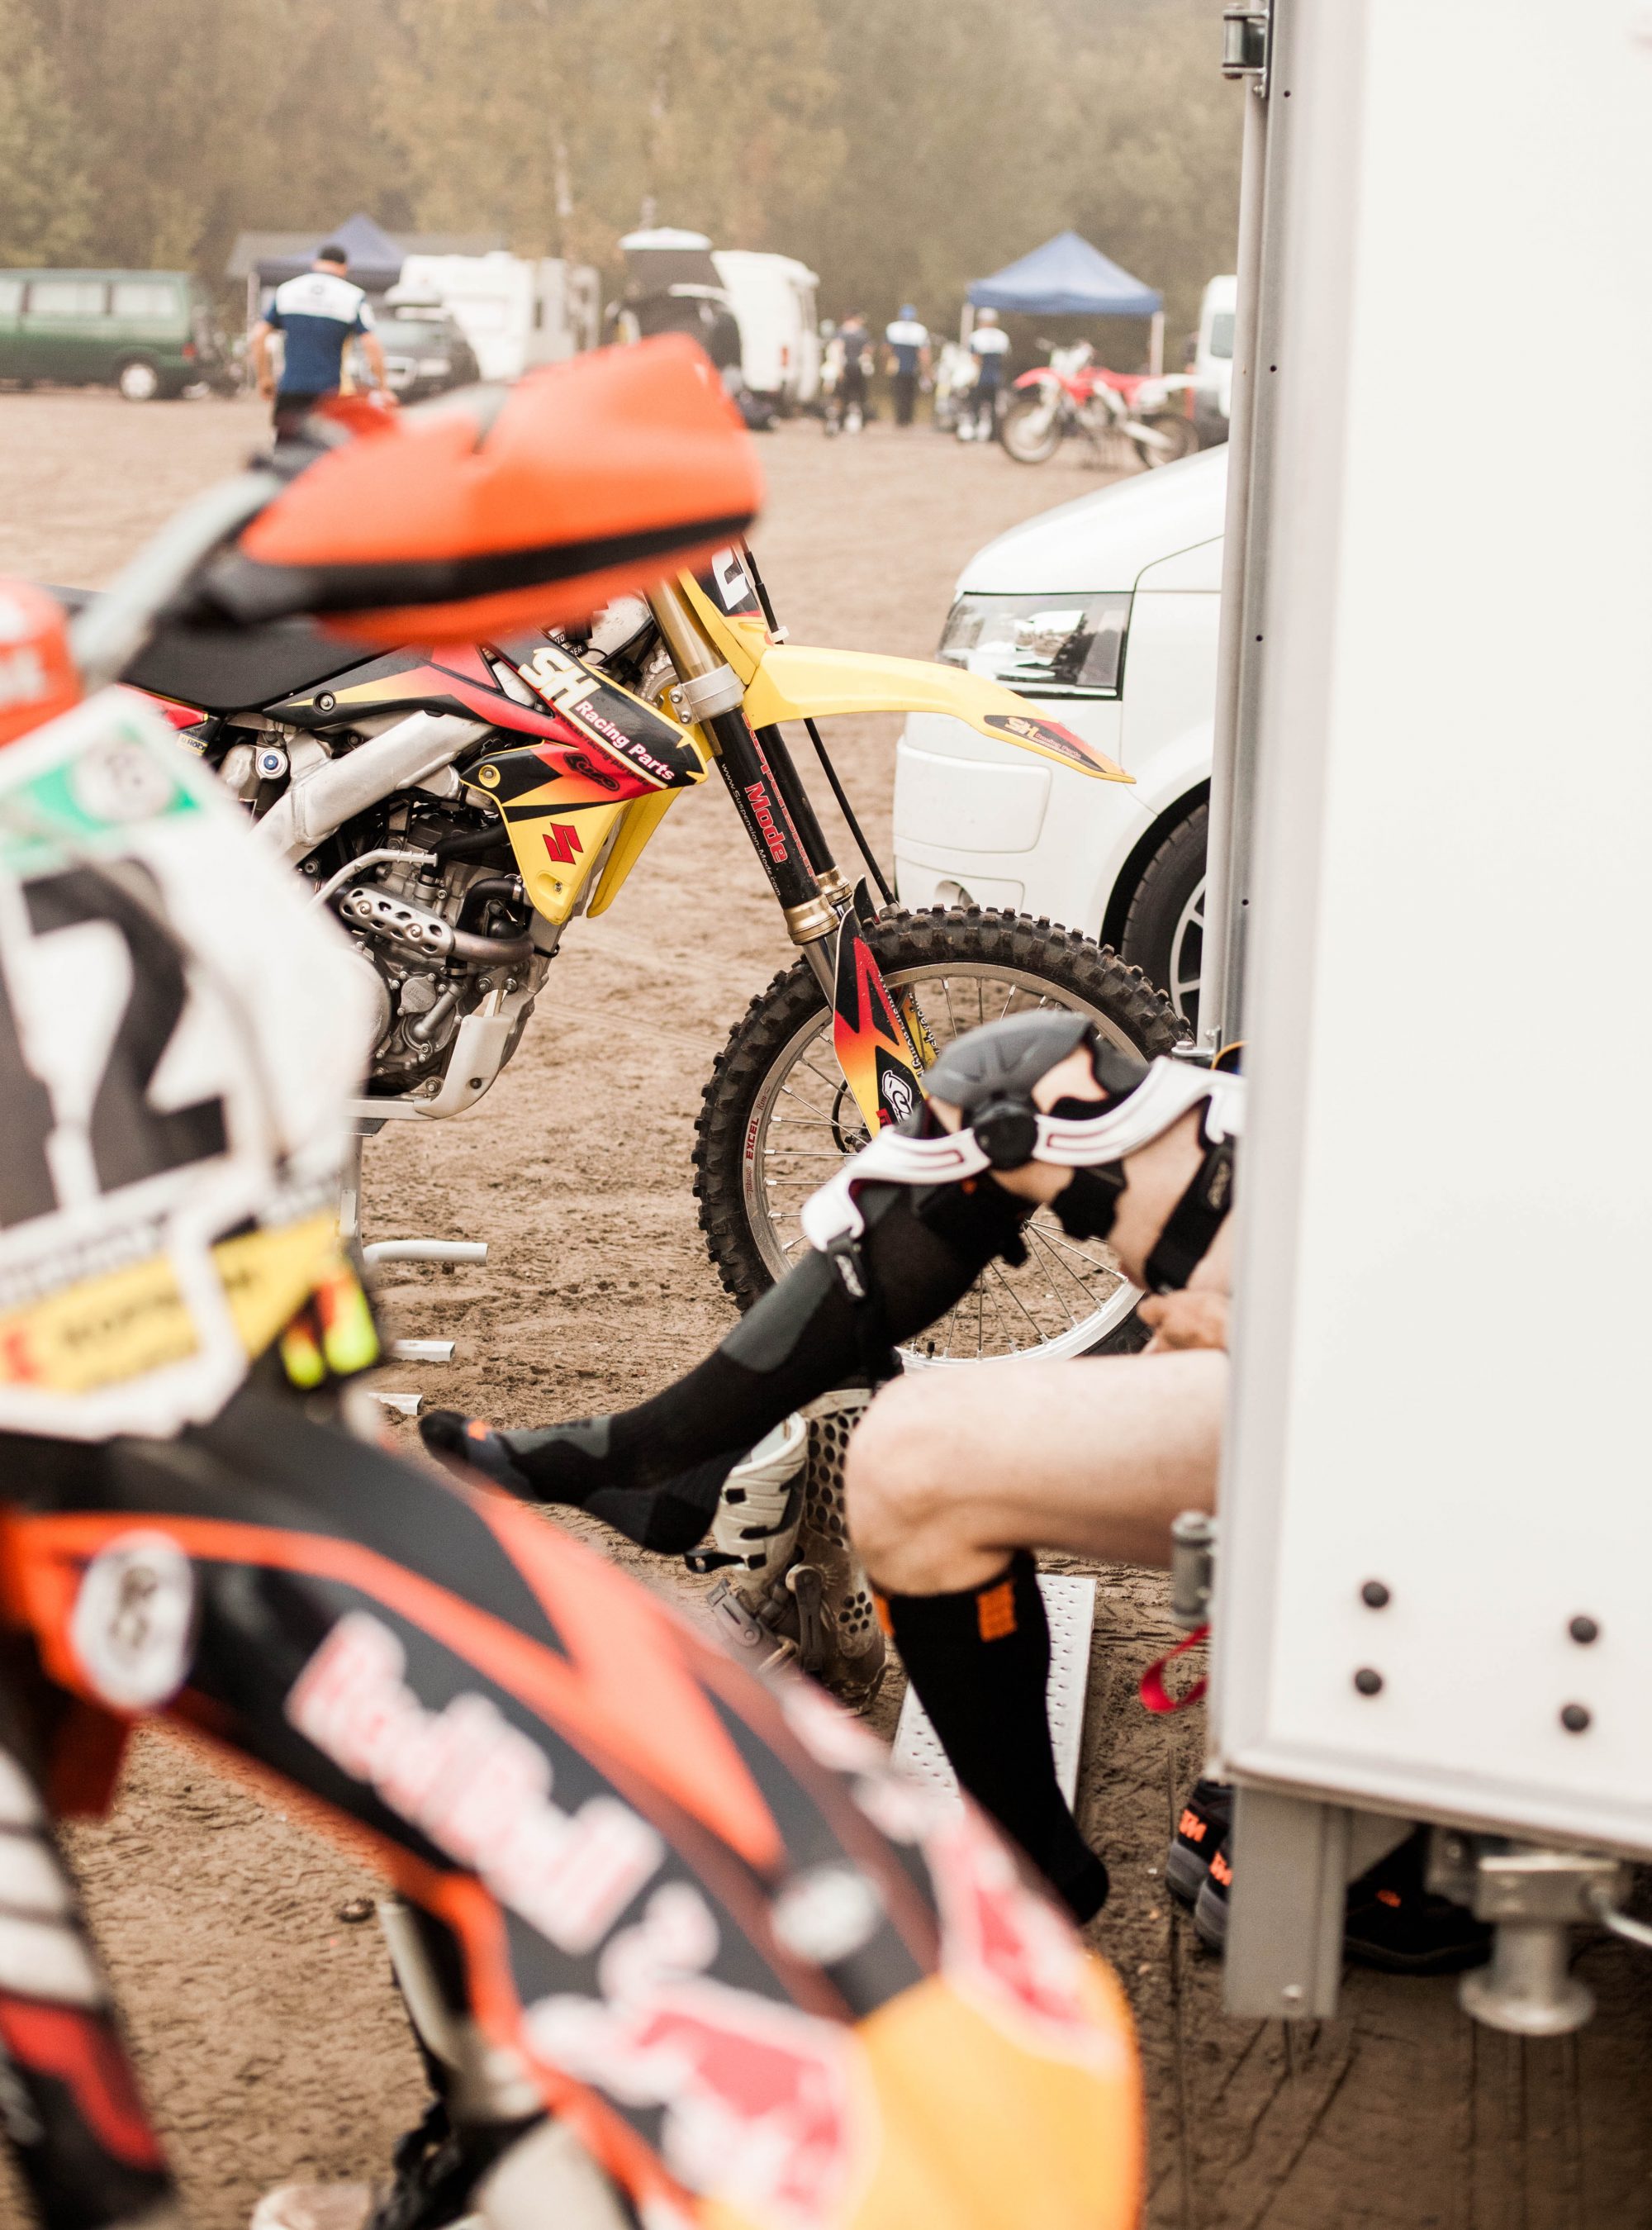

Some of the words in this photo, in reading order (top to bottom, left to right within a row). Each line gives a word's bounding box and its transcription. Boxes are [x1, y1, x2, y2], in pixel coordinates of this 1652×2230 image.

[518, 647, 601, 713] SH
[575, 700, 630, 749] Racing
[628, 743, 675, 781] Parts
[721, 763, 781, 896] www.Suspension-Mode.com
[744, 781, 788, 863] Mode
[746, 1118, 760, 1160] EXCEL
